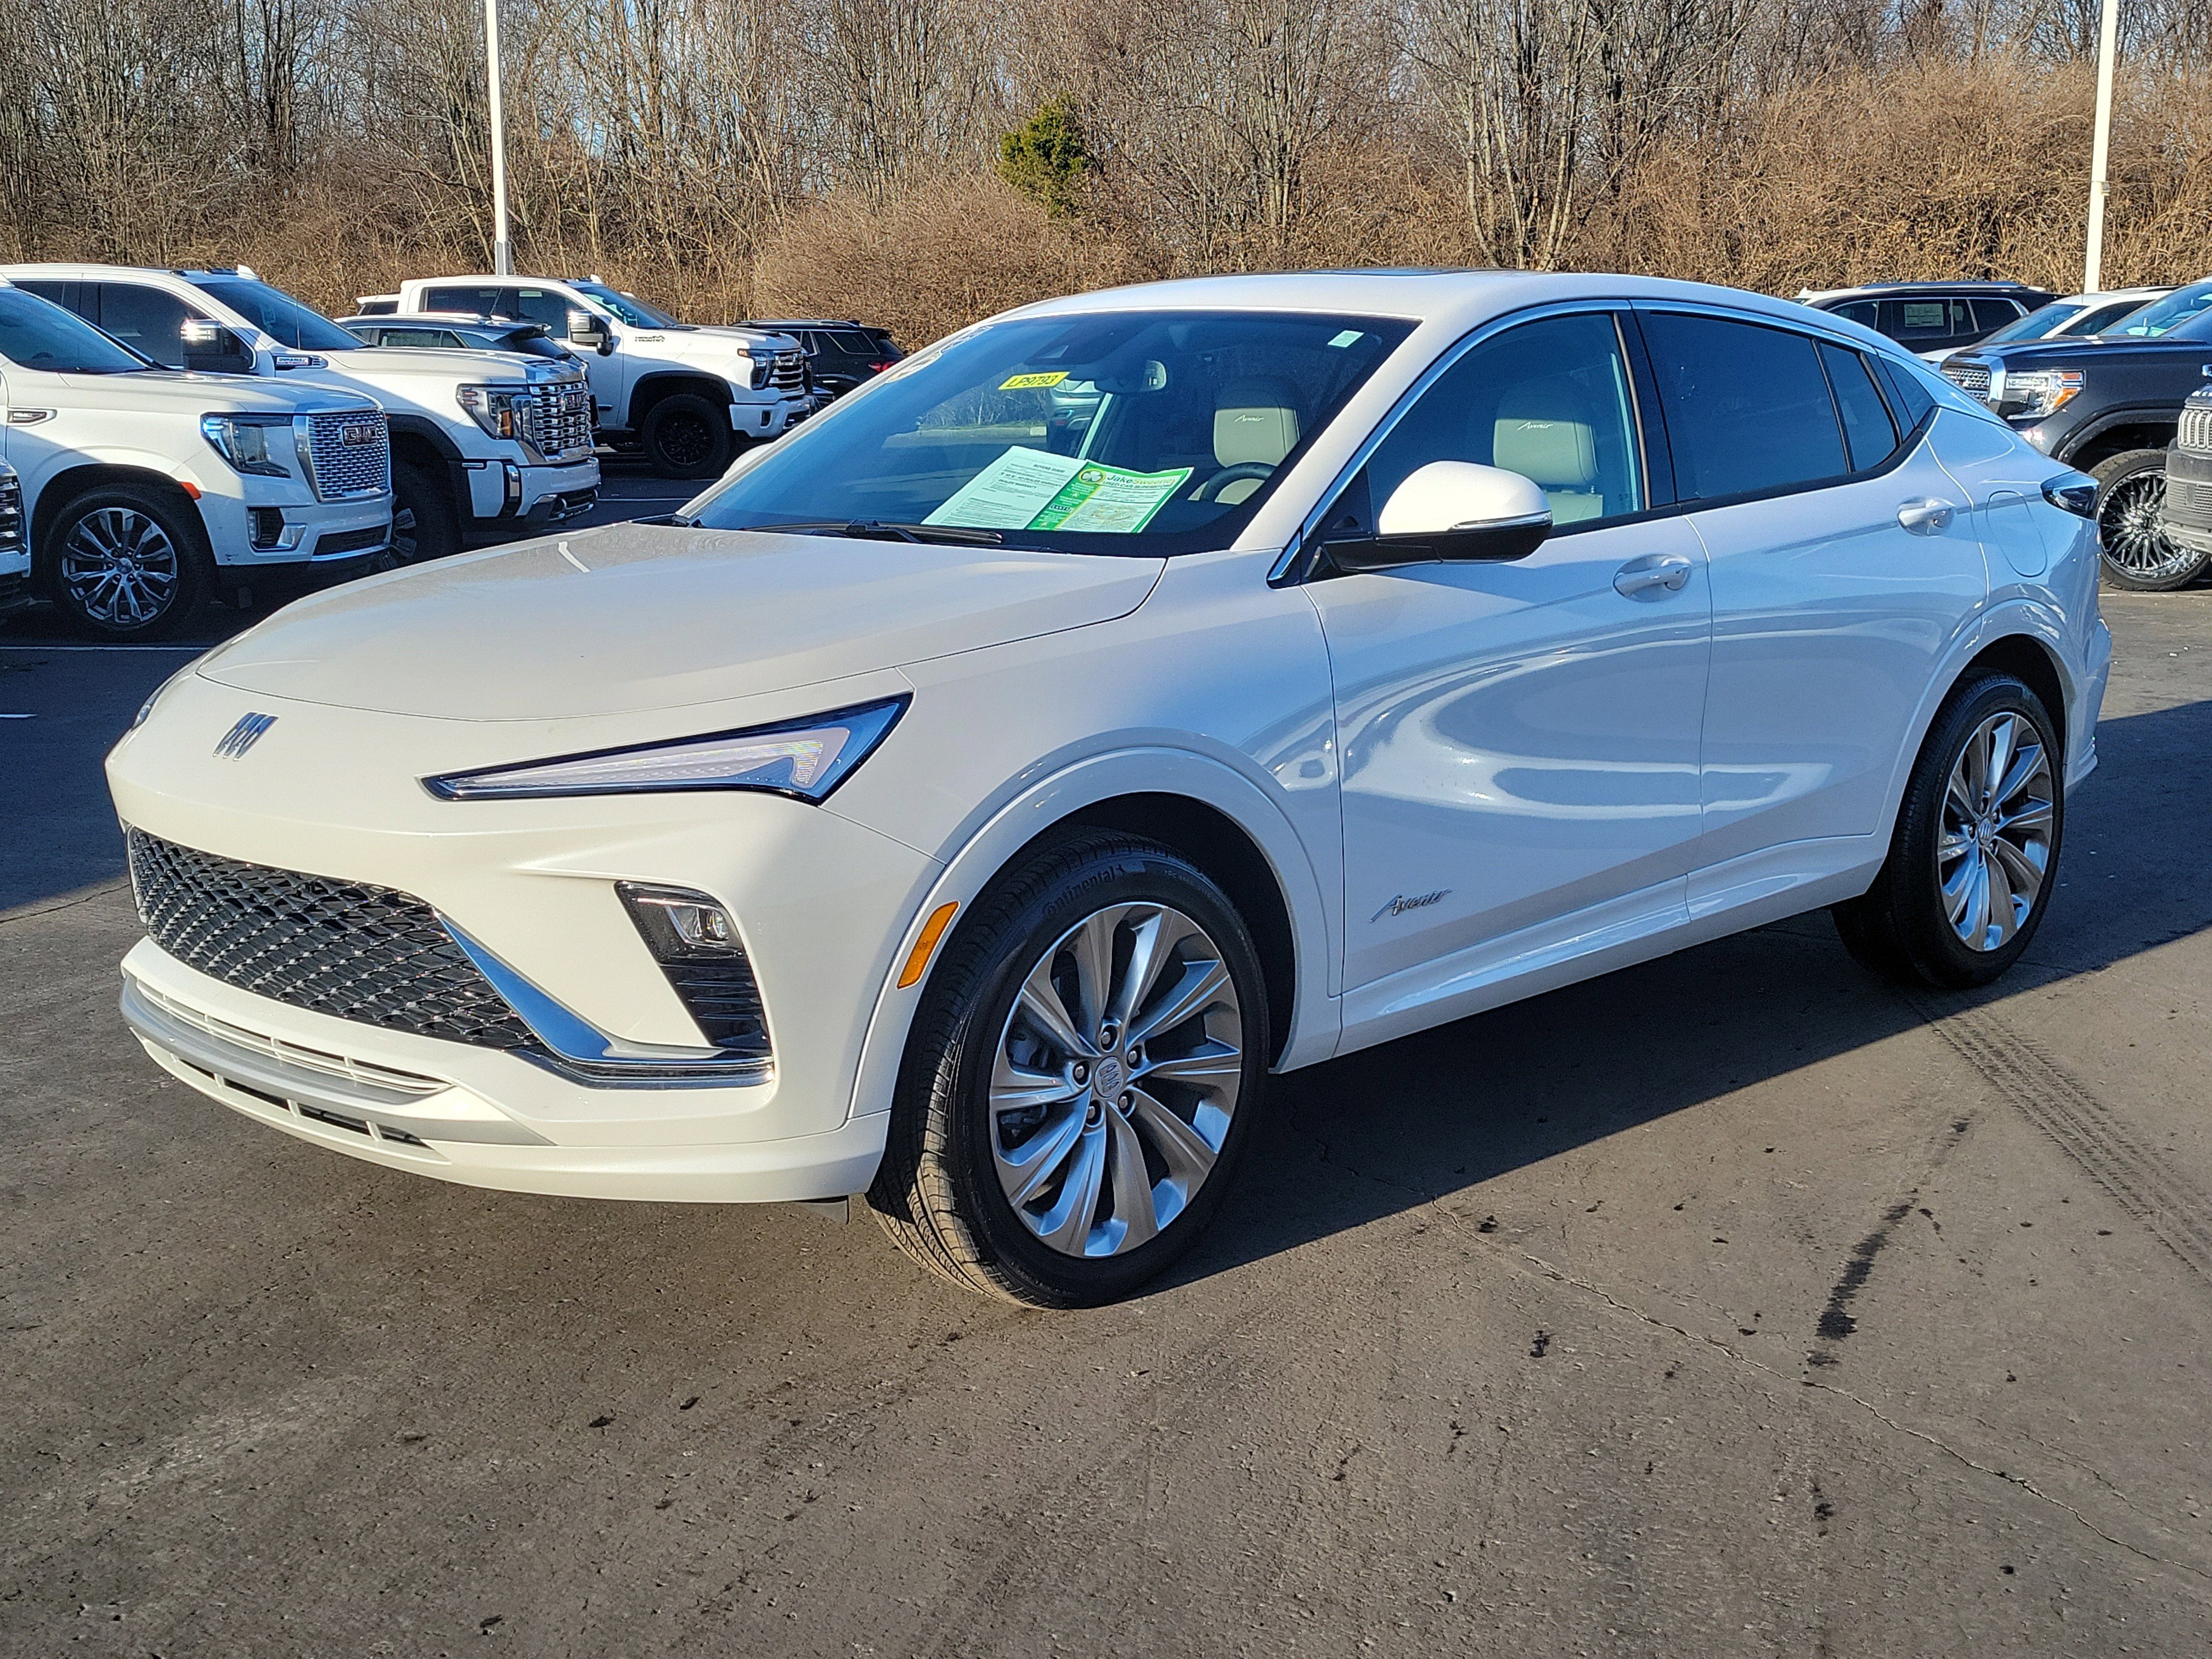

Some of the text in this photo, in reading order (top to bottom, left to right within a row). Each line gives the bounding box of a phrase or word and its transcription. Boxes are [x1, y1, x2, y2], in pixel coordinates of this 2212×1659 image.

[343, 426, 377, 444] GMC
[1045, 865, 1115, 918] Continental
[1368, 888, 1453, 923] Avenir
